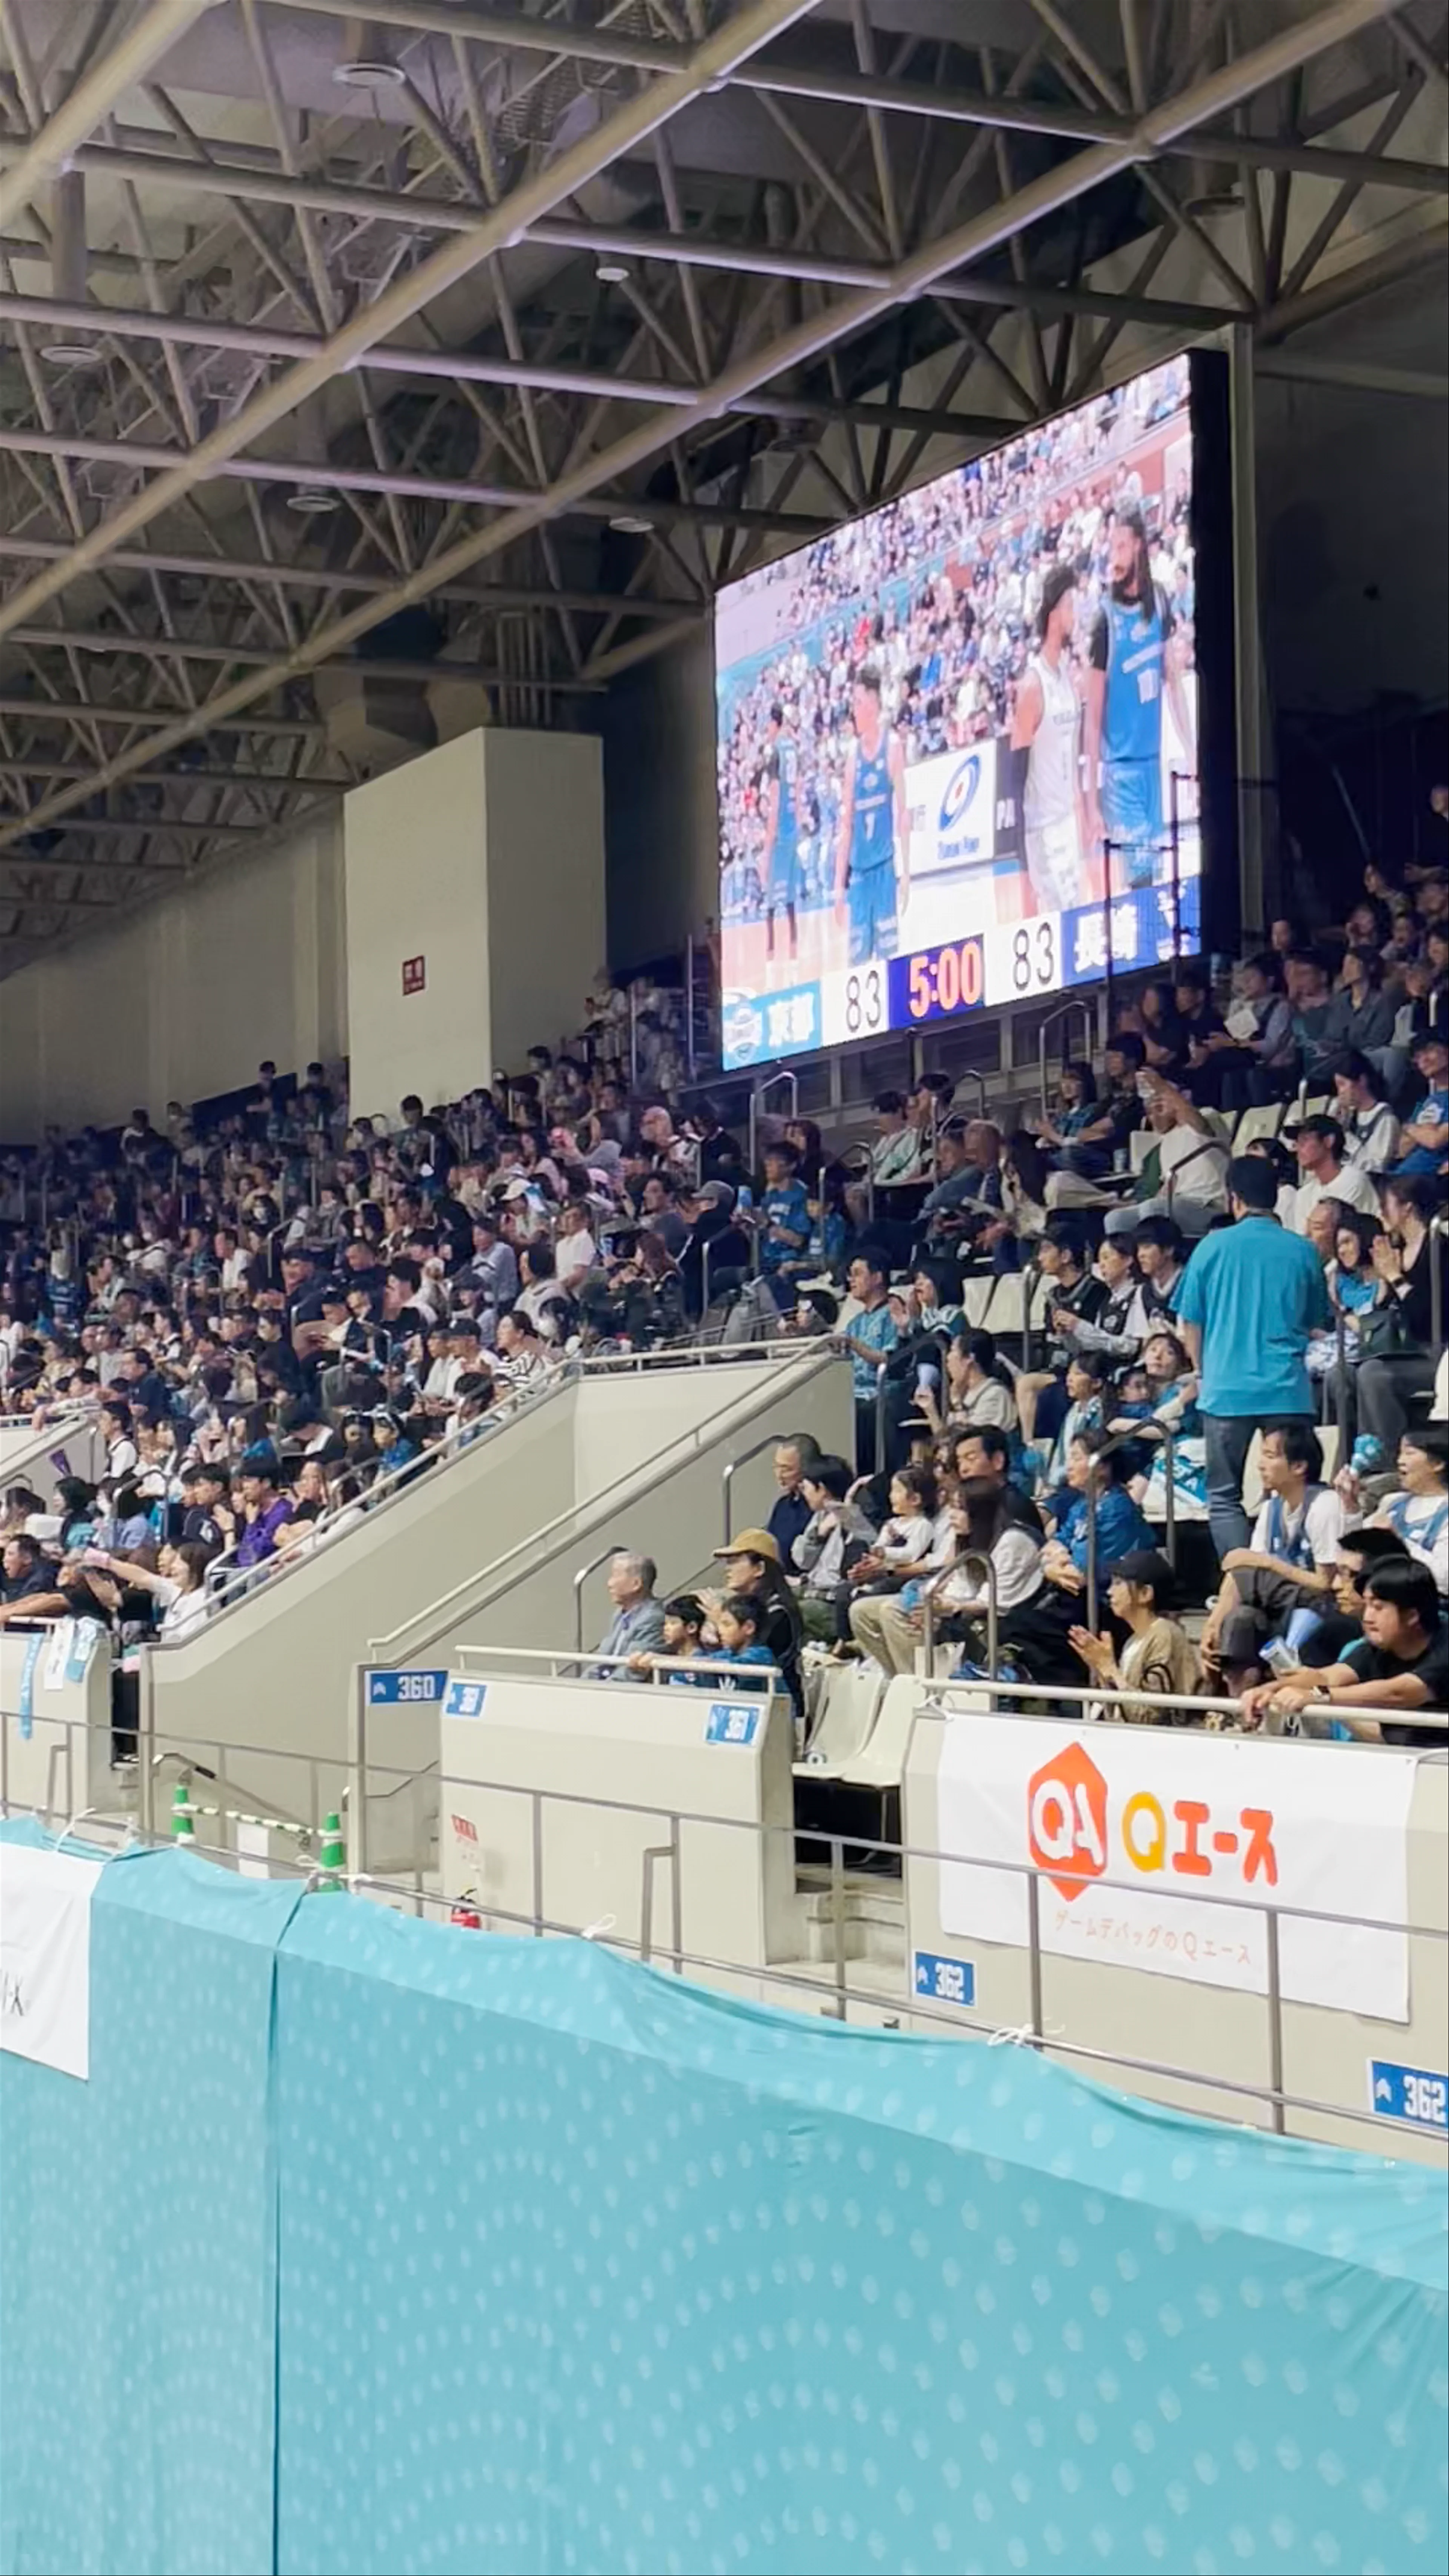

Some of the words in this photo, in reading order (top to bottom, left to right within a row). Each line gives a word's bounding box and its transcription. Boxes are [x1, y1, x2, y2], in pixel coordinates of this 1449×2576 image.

[910, 941, 982, 1018] 5:00
[1013, 921, 1054, 991] 83
[846, 970, 881, 1033] 83
[397, 1674, 435, 1699] 360
[1121, 1791, 1278, 1886] Qエース
[935, 1961, 964, 2001] 362
[1403, 2075, 1447, 2124] 362
